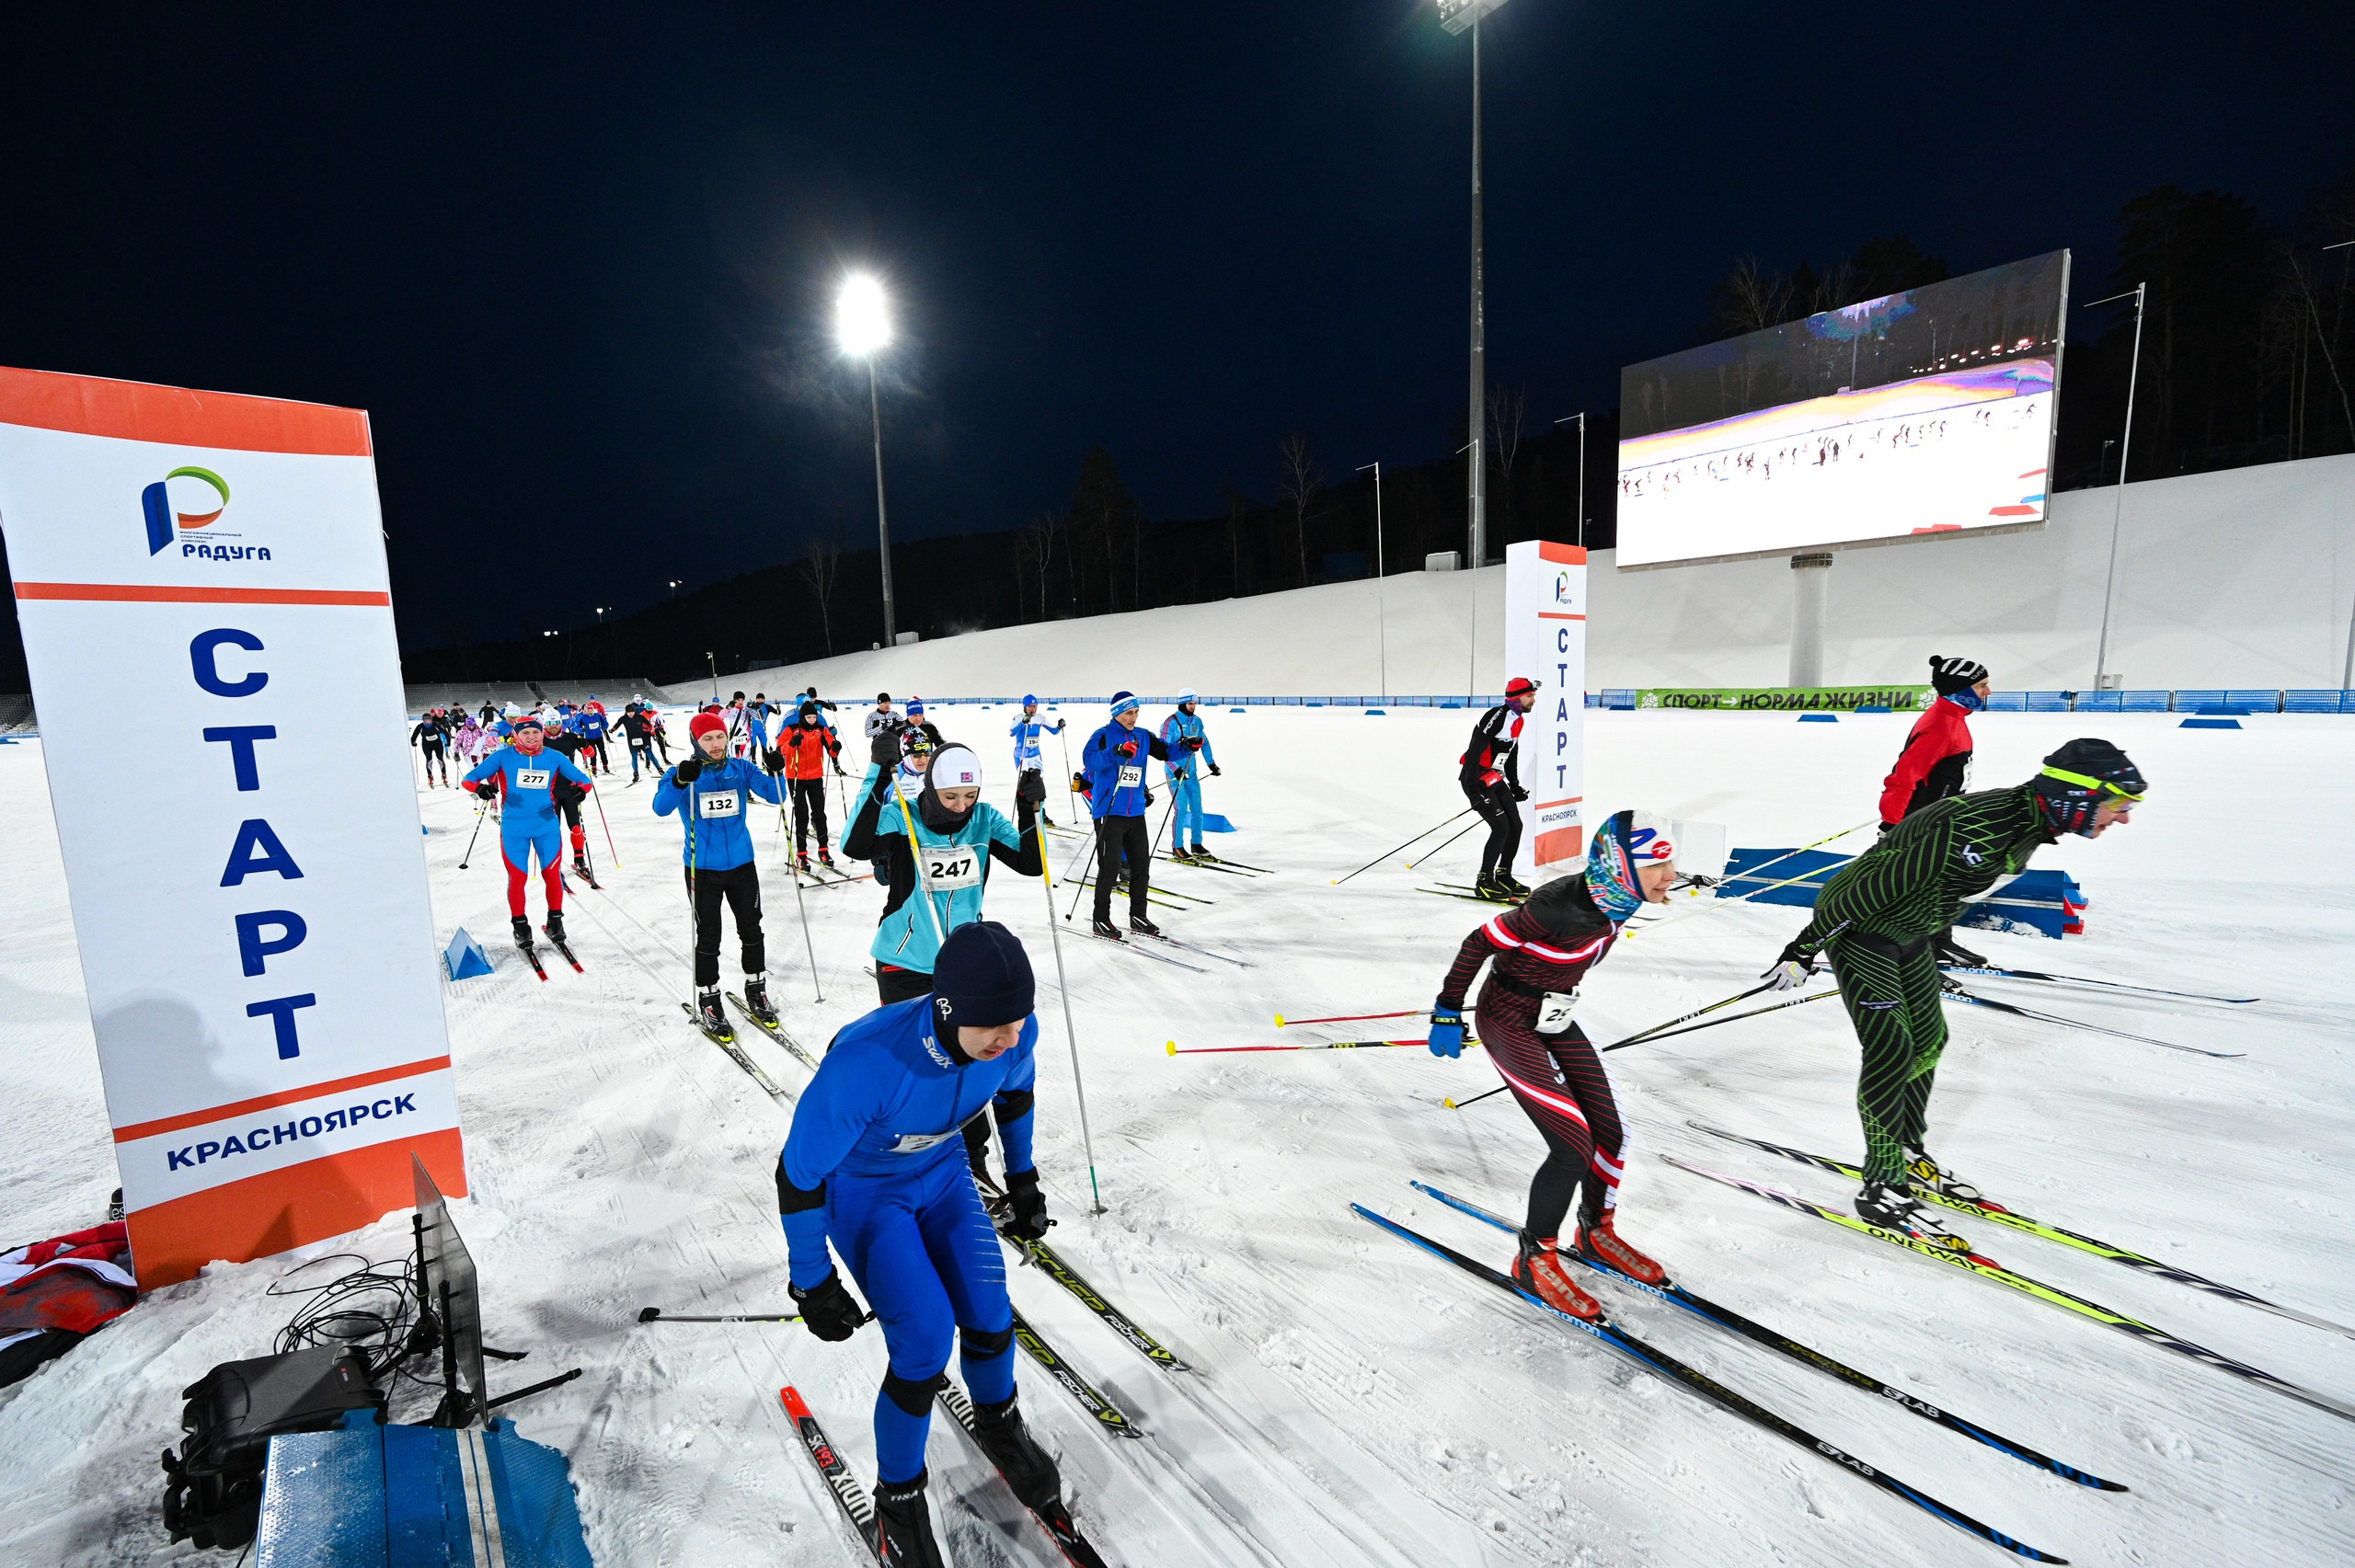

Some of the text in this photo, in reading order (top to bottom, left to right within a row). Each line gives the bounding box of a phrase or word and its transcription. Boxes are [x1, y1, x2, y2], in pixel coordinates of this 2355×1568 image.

[182, 544, 271, 562] РАДУГА
[1557, 628, 1569, 789] СТАРТ
[1663, 692, 1913, 710] СПОРТ НОРМА ЖИЗНИ
[523, 774, 545, 784] 277
[1122, 773, 1139, 782] 292
[708, 799, 733, 810] 132
[1541, 808, 1579, 825] КРАСНОЯРСК
[190, 628, 316, 1060] СТАРТ
[931, 858, 971, 878] 247
[1093, 935, 1125, 946] MADSHUS
[1131, 931, 1164, 943] MADSHUS
[167, 1093, 418, 1172] КРАСНОЯРСК
[1605, 1268, 1667, 1299] salomon
[1541, 1301, 1601, 1337] salomon
[1105, 1315, 1151, 1350] FISCHER
[1053, 1370, 1101, 1411] FISCHER
